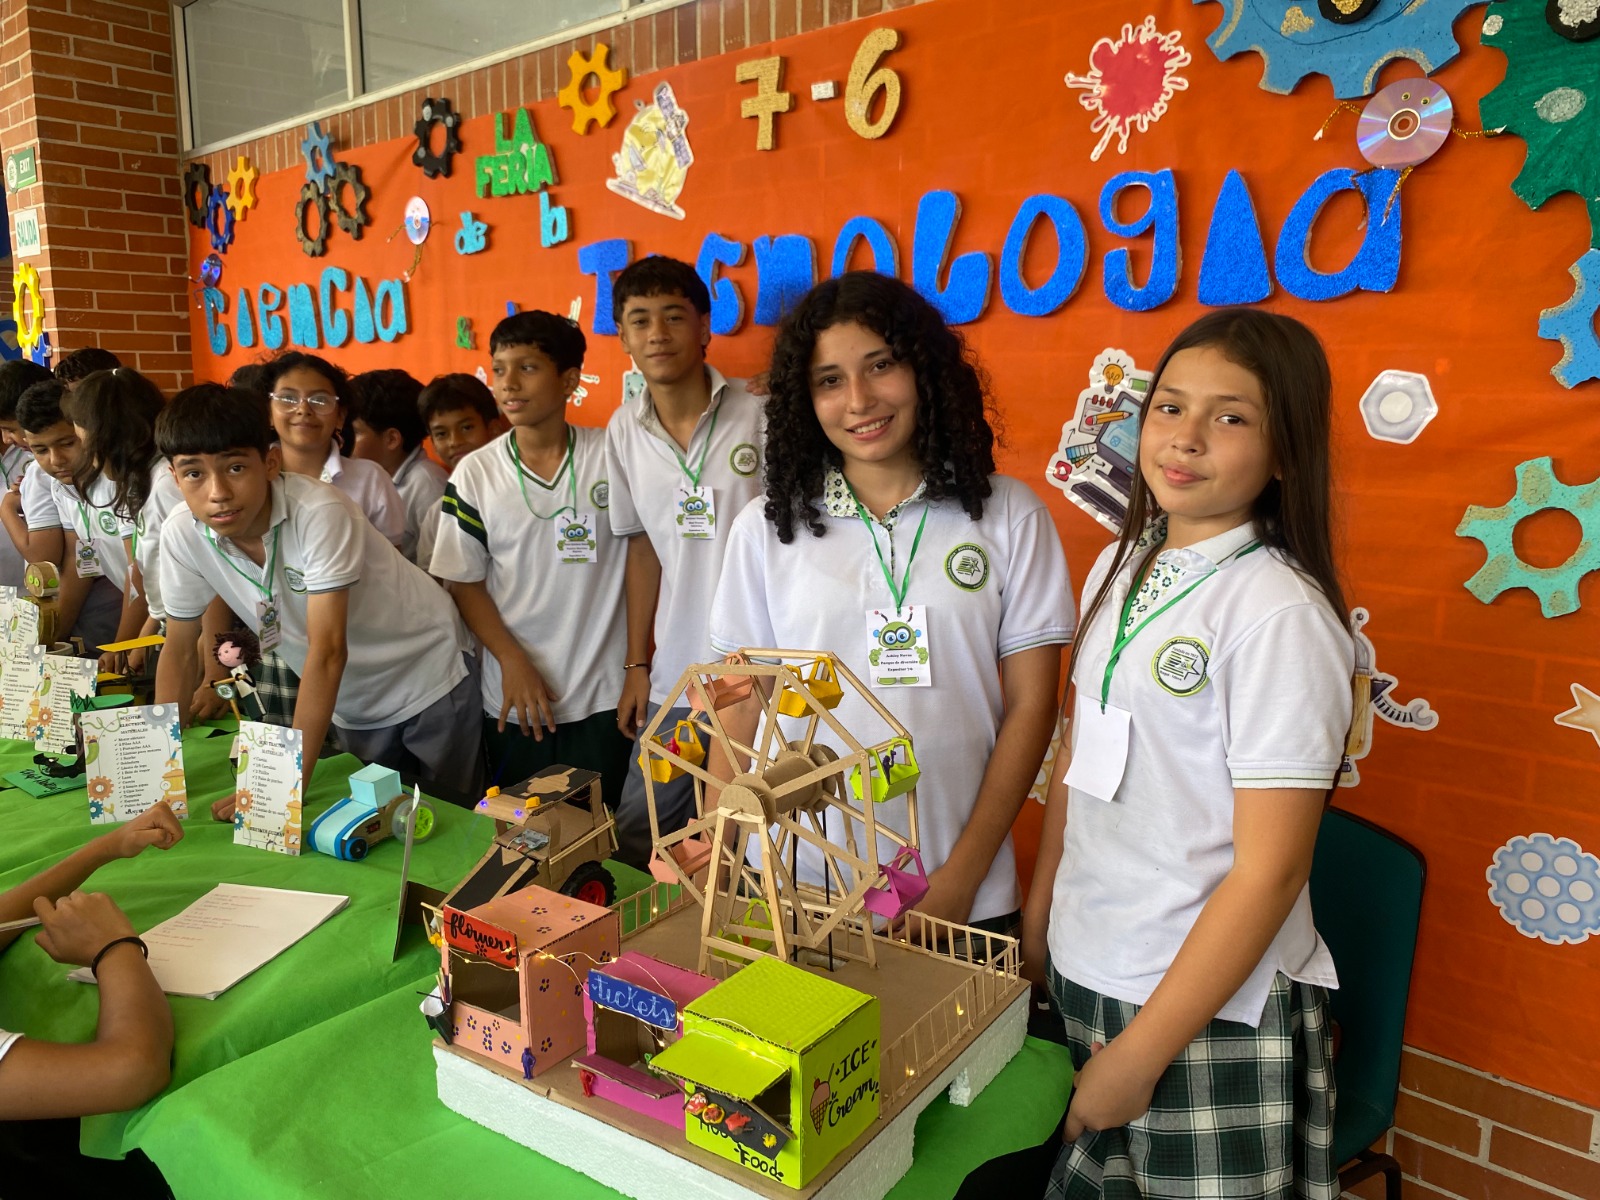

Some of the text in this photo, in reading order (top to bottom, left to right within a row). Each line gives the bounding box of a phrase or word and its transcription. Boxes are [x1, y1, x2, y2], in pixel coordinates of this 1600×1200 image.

[494, 107, 538, 153] LA
[19, 157, 31, 174] EXIT
[475, 143, 557, 198] FERIA
[16, 218, 38, 248] SALIDA
[454, 211, 488, 255] de
[446, 912, 516, 960] flowers
[593, 974, 674, 1028] tickets
[839, 1040, 870, 1083] ICE
[828, 1078, 874, 1127] Cream
[738, 1145, 783, 1181] Food
